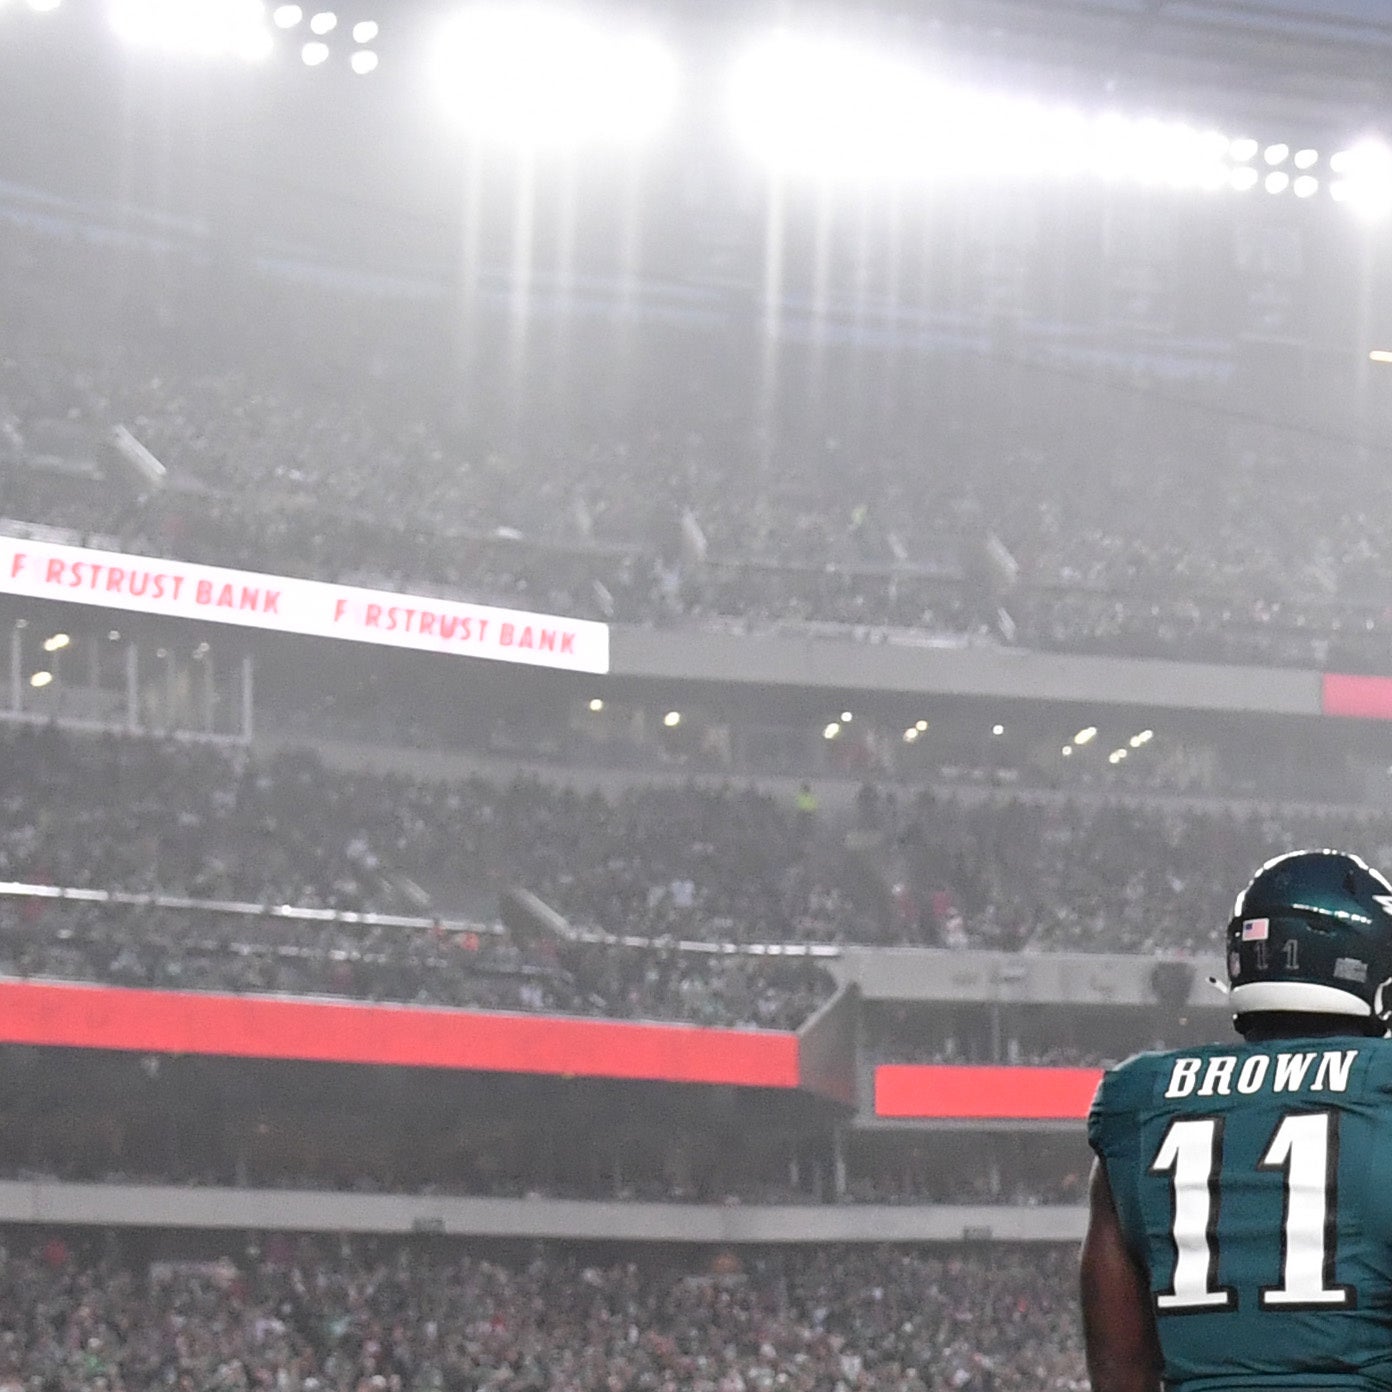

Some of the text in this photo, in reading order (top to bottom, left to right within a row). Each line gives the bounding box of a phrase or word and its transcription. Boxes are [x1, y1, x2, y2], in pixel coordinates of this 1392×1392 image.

[10, 553, 282, 614] FRSTRUST BANK
[333, 599, 577, 654] FRSTRUST BANK
[1256, 939, 1299, 970] 11
[1164, 1050, 1358, 1098] BROWN
[1151, 1110, 1350, 1310] 11
